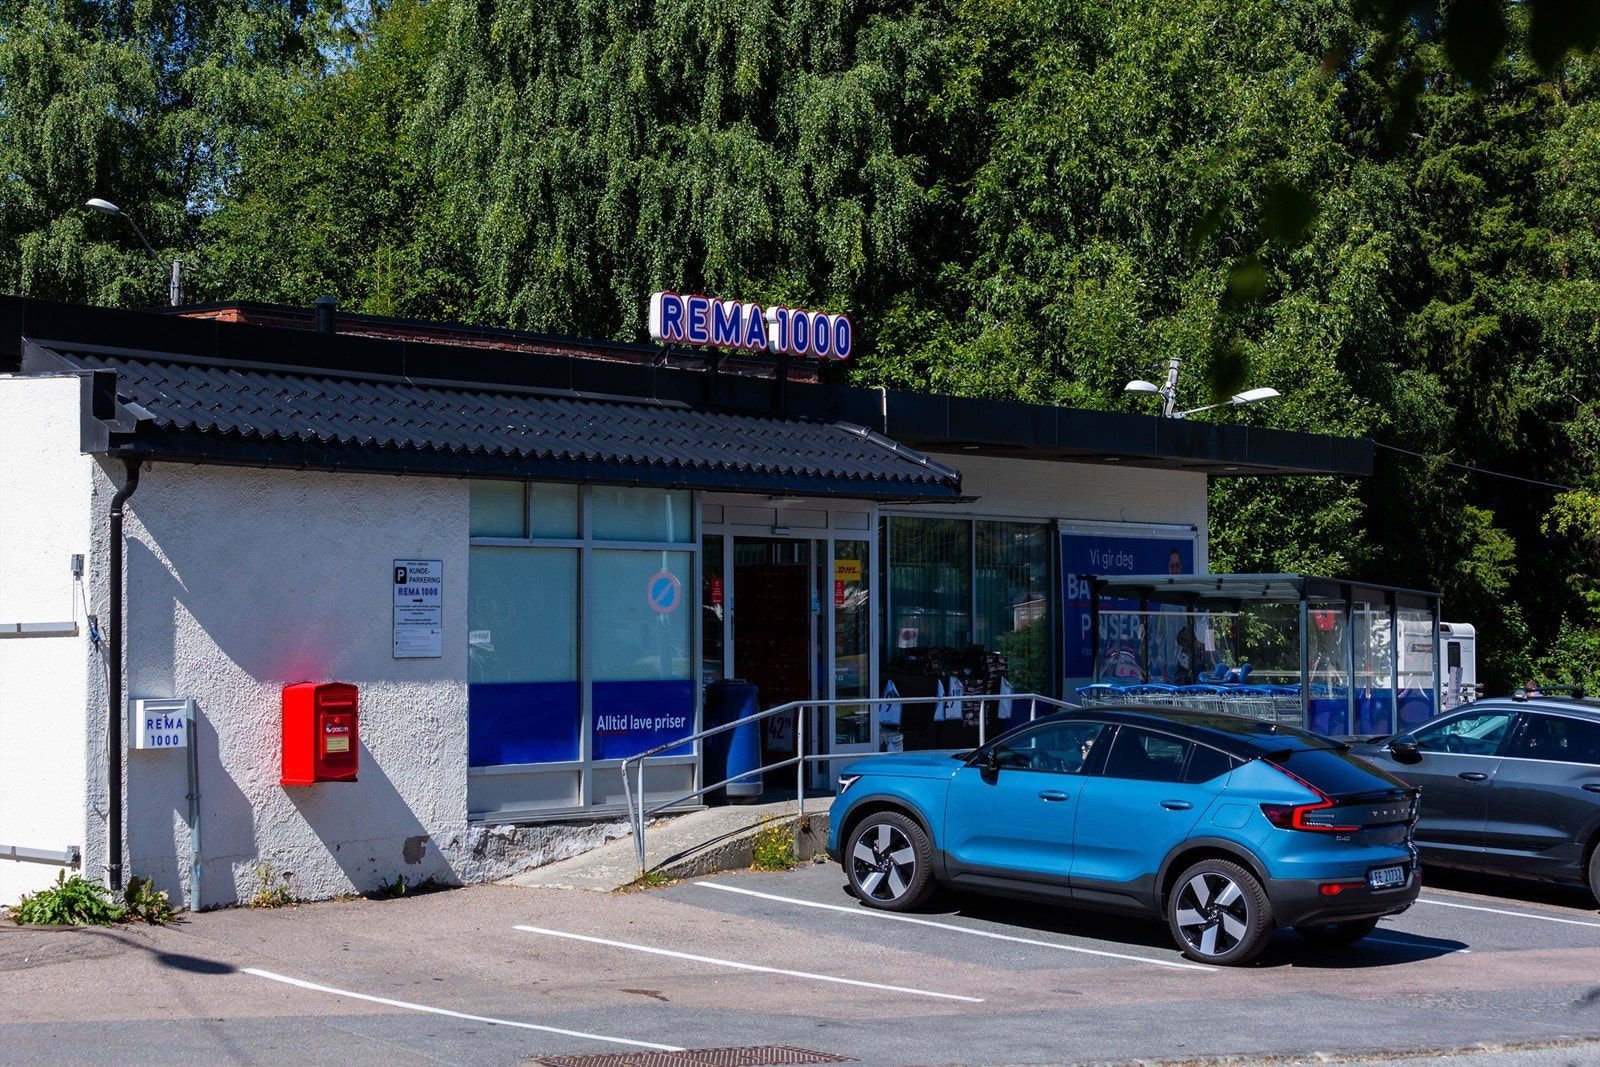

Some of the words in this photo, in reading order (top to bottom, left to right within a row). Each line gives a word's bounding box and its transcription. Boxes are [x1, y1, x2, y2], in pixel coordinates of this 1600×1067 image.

[658, 291, 768, 352] REMA
[774, 305, 853, 360] 1000
[1089, 548, 1100, 565] Vi
[1102, 549, 1115, 569] gir
[1116, 550, 1134, 570] deg
[397, 569, 405, 581] P
[409, 567, 430, 575] KUNDE-
[838, 566, 857, 574] DHL
[409, 576, 441, 584] PARKERING
[398, 587, 420, 596] REMA
[421, 588, 438, 596] 1000
[146, 718, 183, 731] REMA
[596, 714, 628, 732] Alltid
[630, 714, 653, 731] lave
[654, 714, 686, 735] priser
[769, 716, 784, 739] 42
[151, 734, 179, 747] 1000
[1384, 868, 1402, 882] 21732
